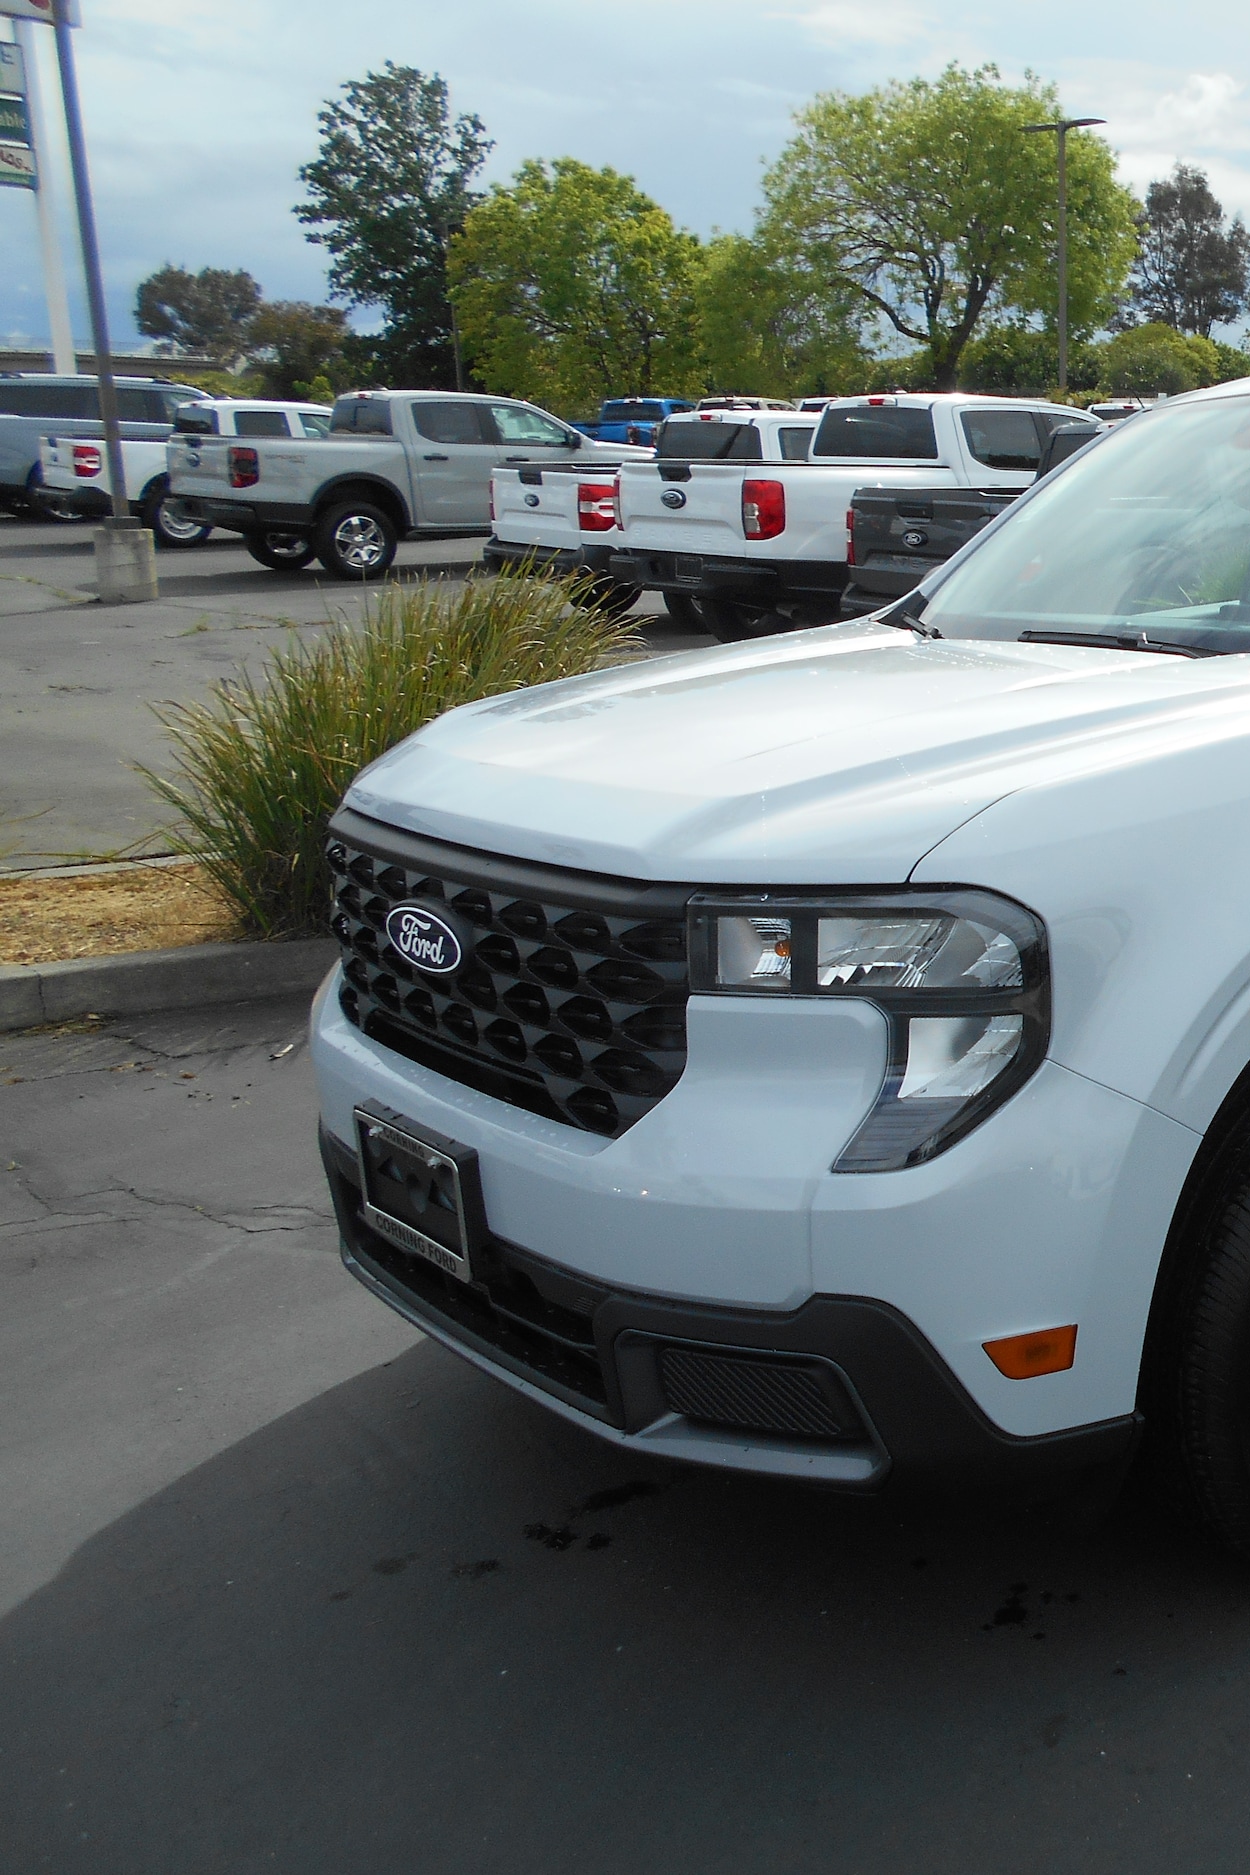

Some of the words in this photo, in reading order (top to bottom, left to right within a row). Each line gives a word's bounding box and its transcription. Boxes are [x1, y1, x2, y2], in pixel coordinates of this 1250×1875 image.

[400, 913, 444, 964] Ford
[375, 1213, 425, 1254] CORNING
[427, 1243, 457, 1273] FORD
